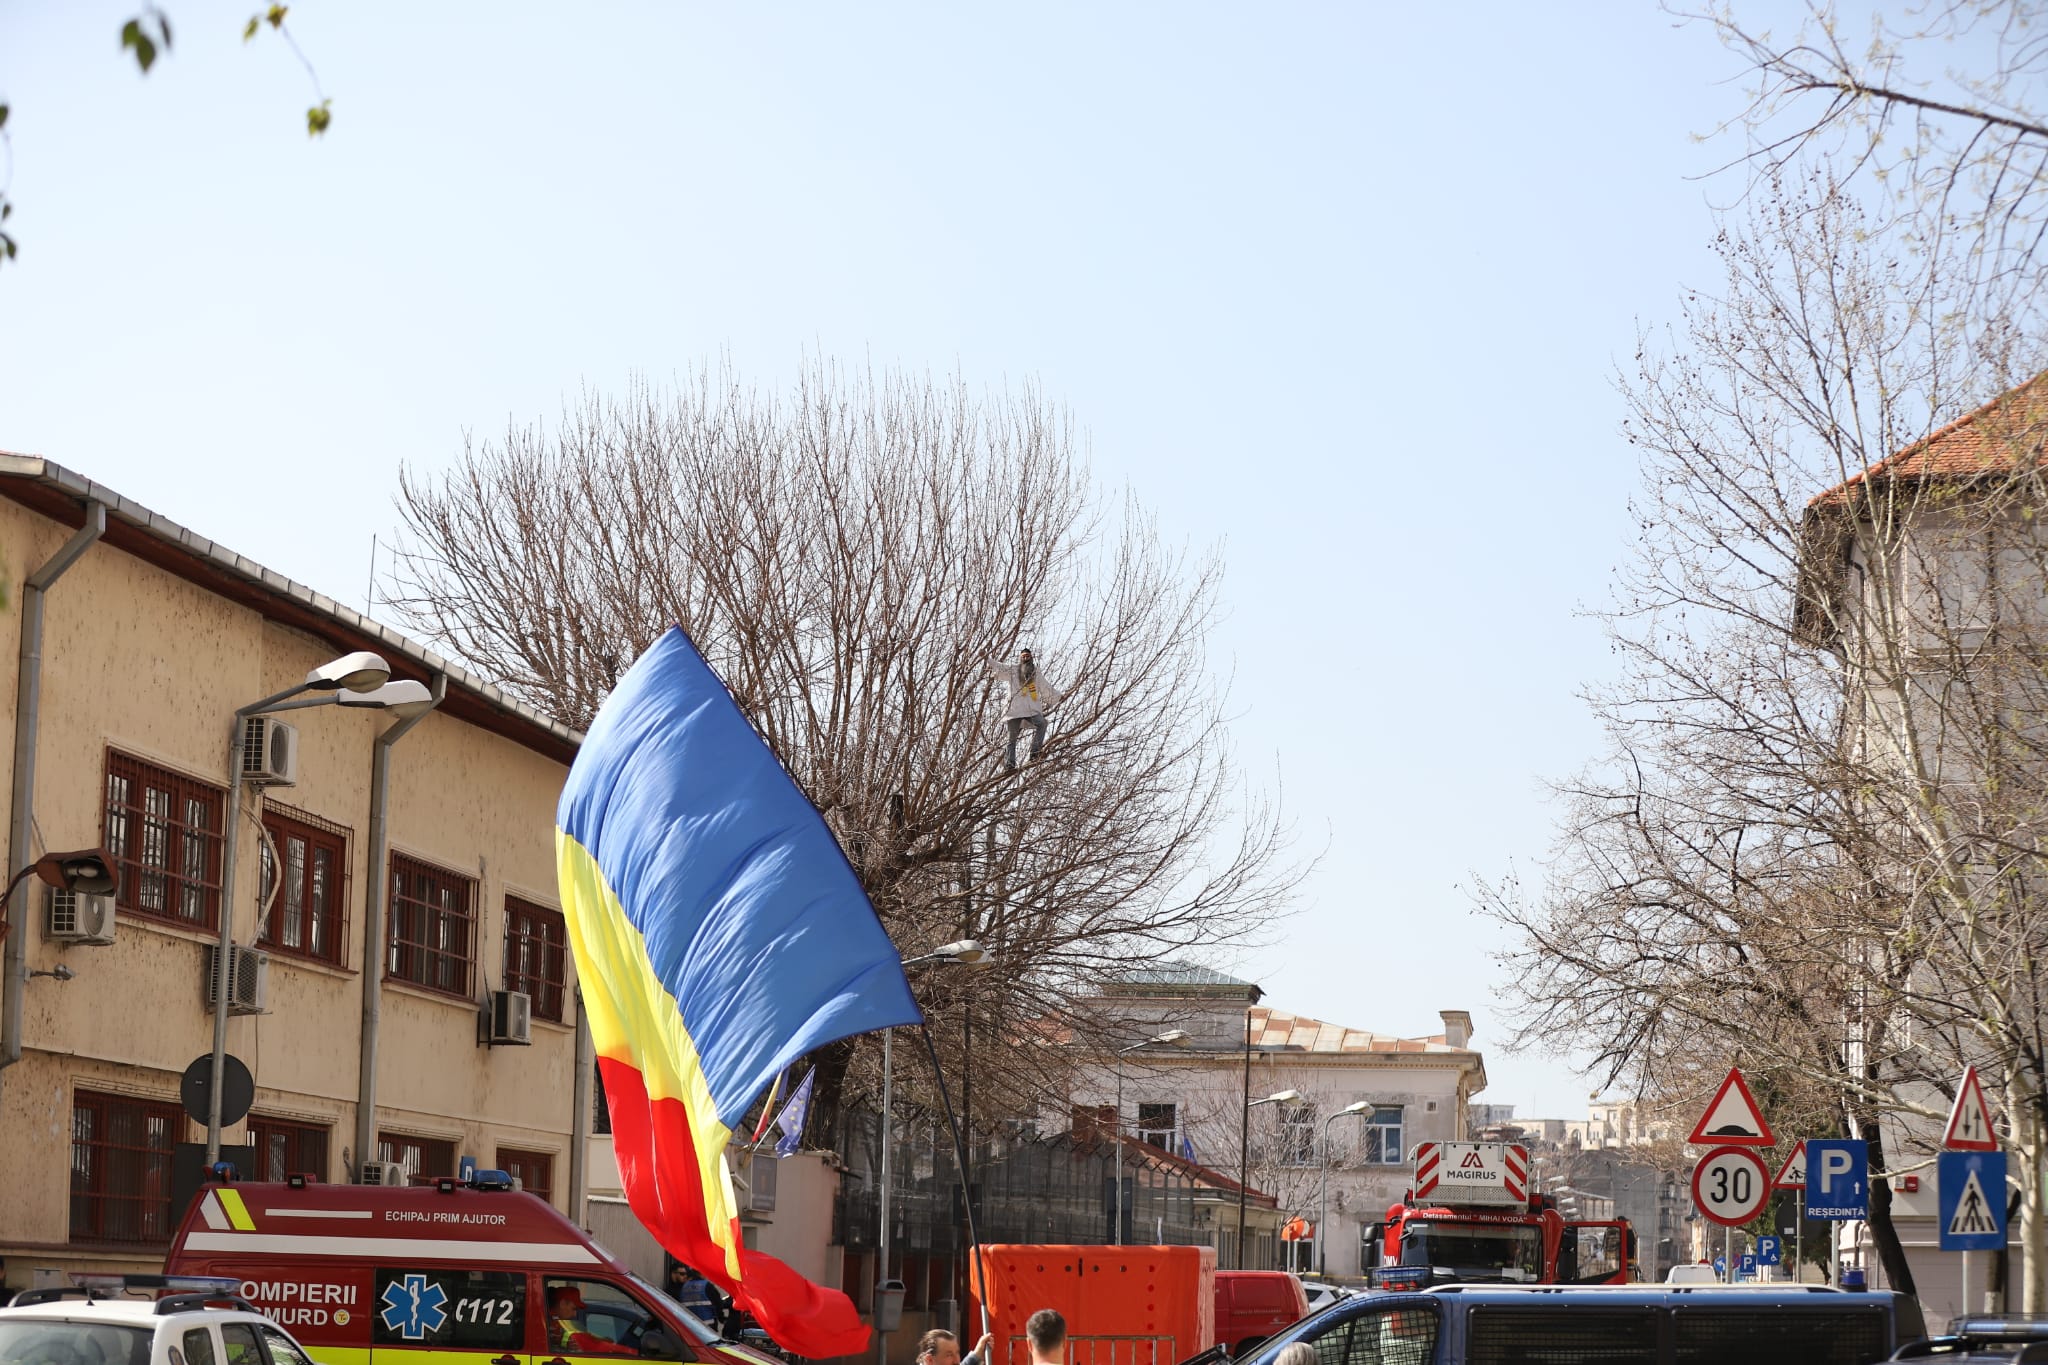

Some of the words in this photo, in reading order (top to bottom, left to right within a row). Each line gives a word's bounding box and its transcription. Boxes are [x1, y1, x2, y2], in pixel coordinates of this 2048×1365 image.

[1447, 1170, 1497, 1180] MAGIRUS
[1821, 1149, 1853, 1193] P
[1710, 1166, 1751, 1204] 30
[385, 1210, 431, 1222] ECHIPAJ
[433, 1212, 460, 1223] PRIM
[462, 1213, 506, 1225] AJUTOR
[1762, 1239, 1775, 1256] P
[1743, 1257, 1753, 1270] P
[240, 1280, 357, 1305] OMPIERII
[468, 1298, 514, 1325] 112
